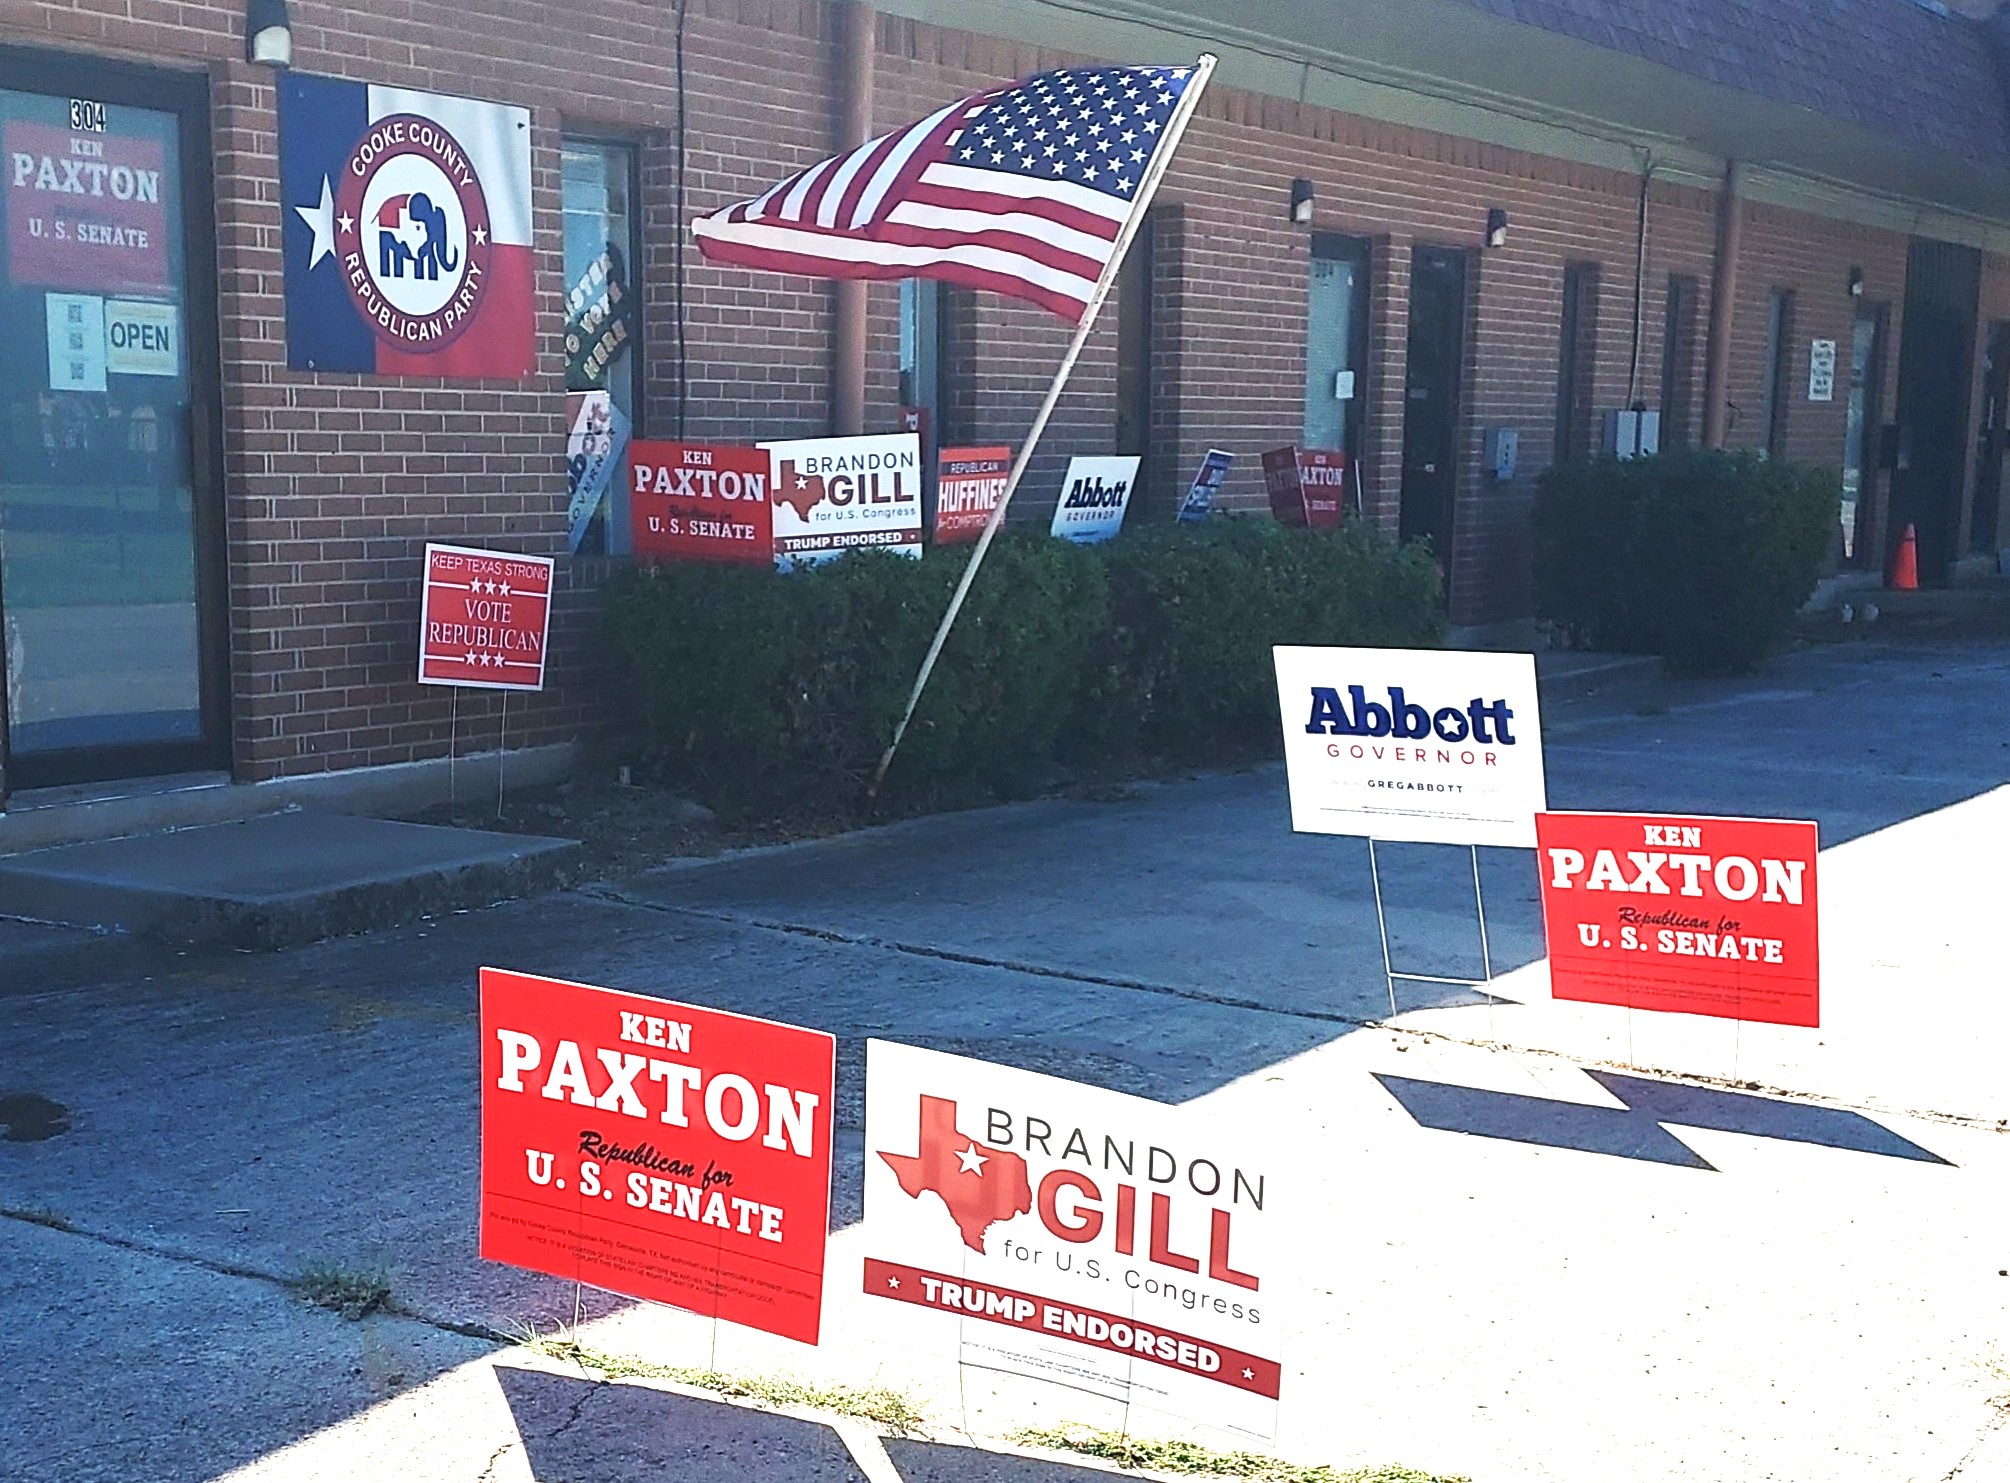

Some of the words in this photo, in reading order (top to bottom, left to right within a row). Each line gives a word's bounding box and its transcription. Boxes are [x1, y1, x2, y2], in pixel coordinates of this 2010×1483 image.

[71, 100, 105, 132] 304
[70, 138, 103, 156] KEN
[352, 122, 405, 176] COOKE
[409, 123, 473, 187] COUNTY
[12, 152, 160, 203] PAXTON
[29, 218, 48, 238] U.
[55, 221, 71, 240] S.
[77, 223, 148, 248] SENATE
[345, 252, 443, 342] REPUBLICAN
[444, 260, 483, 330] PARTY
[110, 321, 169, 352] OPEN
[683, 450, 712, 466] KEN
[806, 451, 914, 474] BRANDON
[951, 462, 998, 474] REPUBLICAN
[634, 465, 766, 502] PAXTON
[828, 472, 914, 507] GILL
[1300, 466, 1344, 485] AXTON
[1064, 477, 1127, 508] Abbott
[648, 517, 665, 532] U.
[670, 518, 684, 534] S.
[689, 520, 755, 540] SENATE
[815, 512, 831, 521] for
[836, 510, 858, 520] U.S.
[862, 507, 916, 519] Congress
[785, 536, 830, 550] TRUMP
[833, 531, 902, 547] ENDORSED
[431, 554, 463, 570] KEEP
[466, 558, 502, 575] TEXAS
[505, 563, 548, 580] STRONG
[465, 599, 512, 623] VOTE
[429, 622, 541, 651] REPUBLICAN
[1305, 685, 1515, 745] Abbott
[1327, 743, 1497, 767] GOVERNOR
[1643, 825, 1701, 848] KEN
[1547, 848, 1806, 905] PAXTON
[1618, 906, 1711, 931] Republican
[1715, 918, 1742, 936] for
[1577, 922, 1611, 949] U.
[1620, 926, 1648, 952] S.
[1658, 931, 1785, 964] SENATE
[620, 1011, 692, 1053] KEN
[497, 1028, 820, 1159] PAXTON
[578, 1130, 695, 1177] Republican
[701, 1160, 734, 1190] for
[987, 1107, 1265, 1211] BRANDON
[525, 1149, 566, 1189] U.
[579, 1162, 613, 1201] S.
[627, 1173, 783, 1243] SENATE
[1037, 1169, 1260, 1292] GILL
[1004, 1239, 1042, 1264] for
[1056, 1251, 1111, 1283] U.S.
[1124, 1270, 1261, 1324] Congress
[920, 1276, 1036, 1324] TRUMP
[1043, 1305, 1221, 1374] ENDORSED
